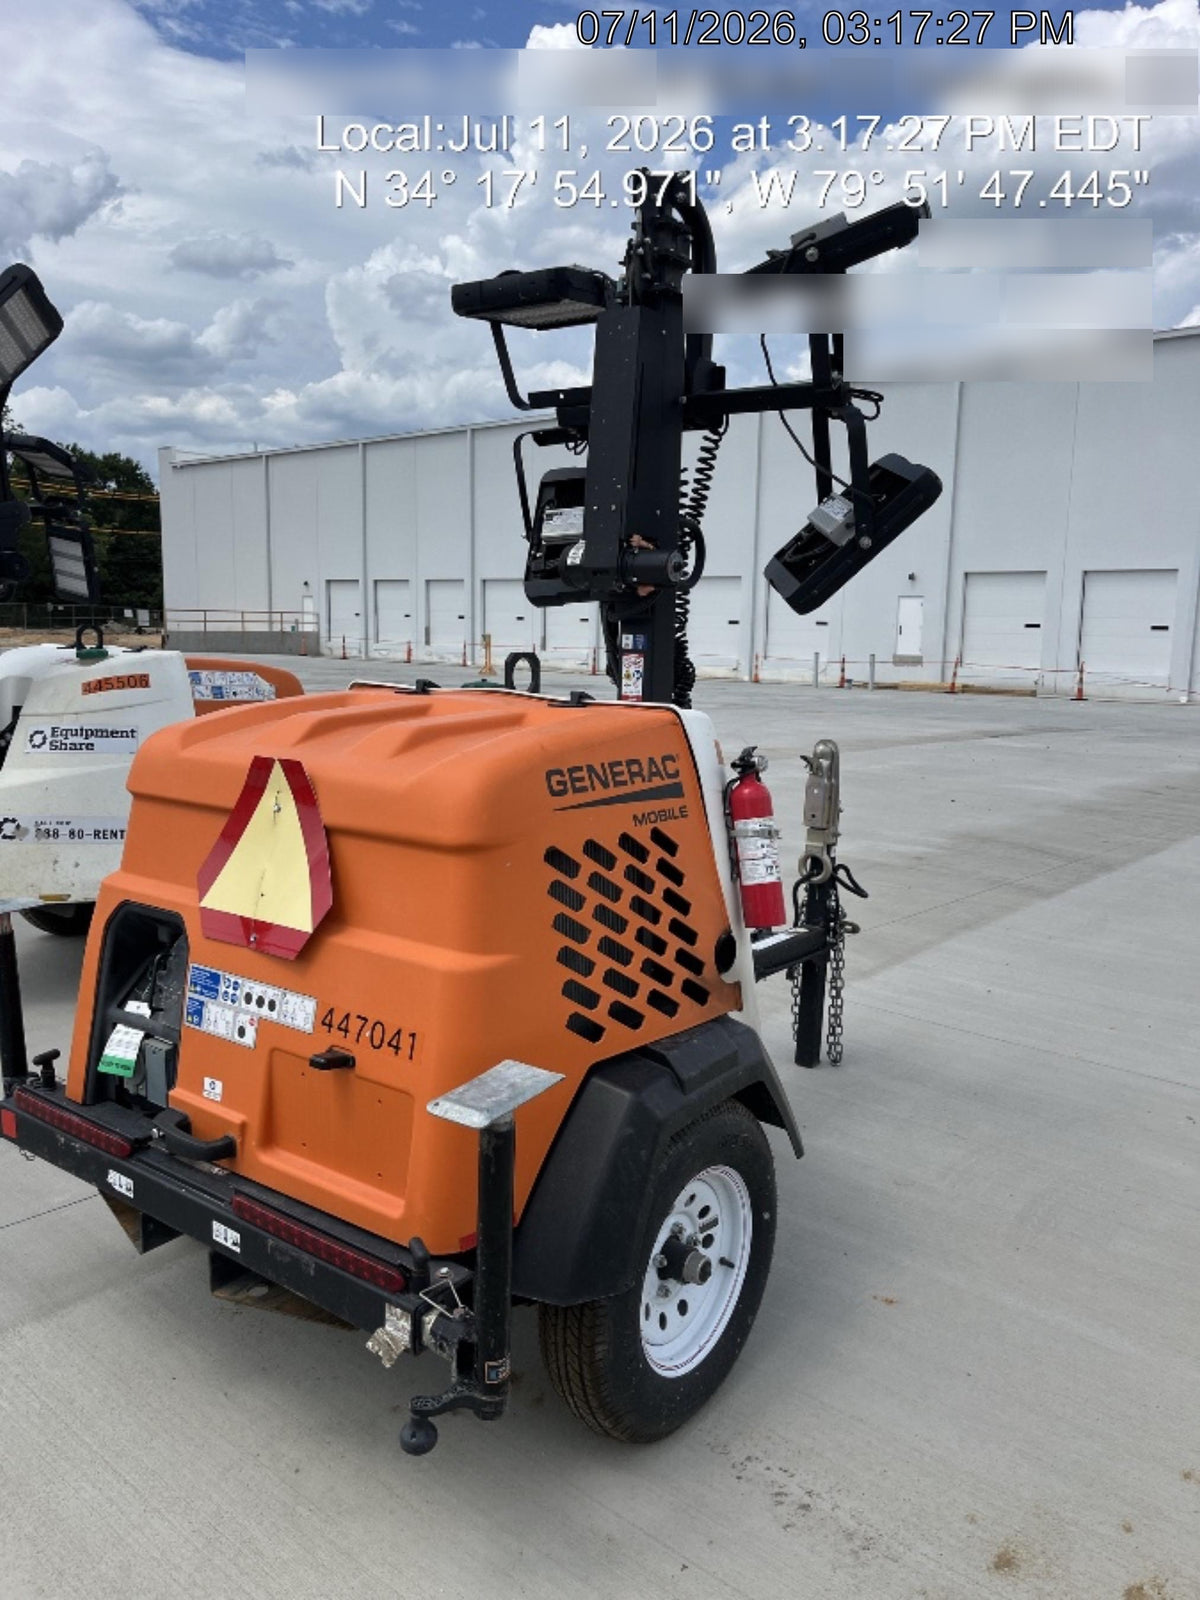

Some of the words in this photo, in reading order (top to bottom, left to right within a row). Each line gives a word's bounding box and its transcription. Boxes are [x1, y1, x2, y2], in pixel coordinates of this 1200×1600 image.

[83, 675, 149, 694] 445506
[51, 726, 136, 740] Equipment
[49, 739, 95, 751] Share
[545, 754, 680, 797] GENERAC
[632, 805, 688, 827] MOBILE
[321, 1007, 417, 1061] 447041
